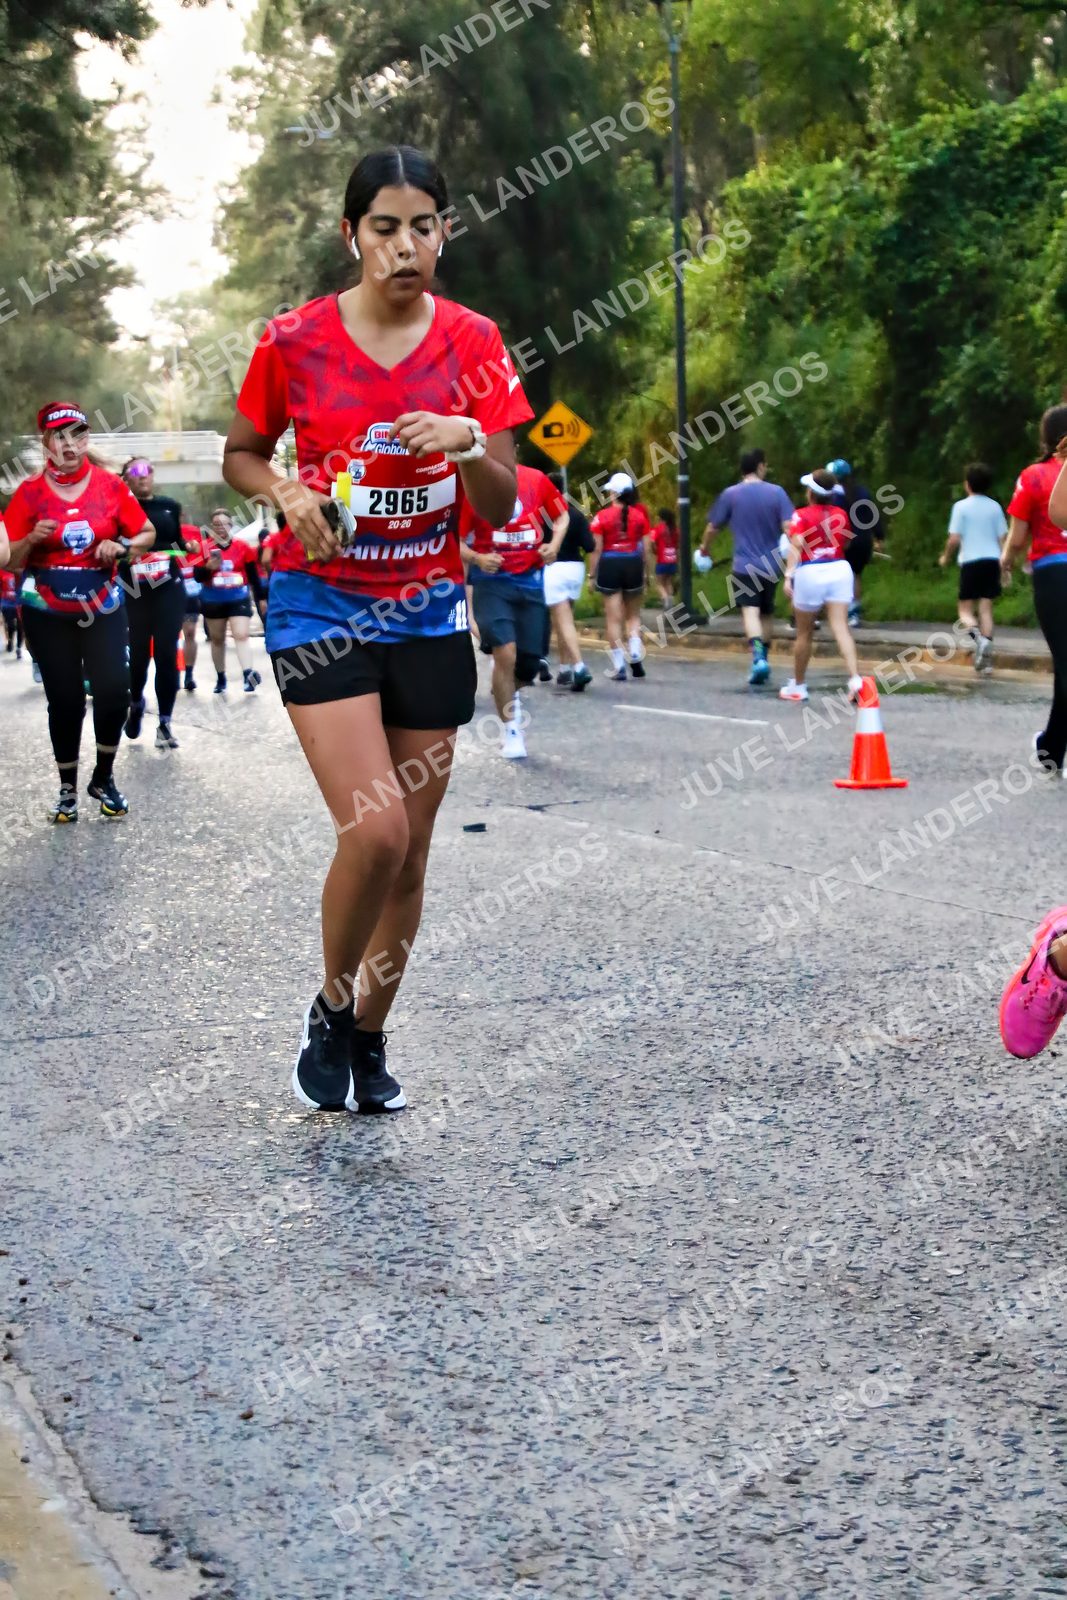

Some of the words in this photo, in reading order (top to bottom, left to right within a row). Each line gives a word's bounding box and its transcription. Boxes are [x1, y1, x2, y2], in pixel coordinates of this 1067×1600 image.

[369, 487, 429, 515] 2965
[387, 519, 412, 530] 20-26
[436, 521, 448, 532] 5K
